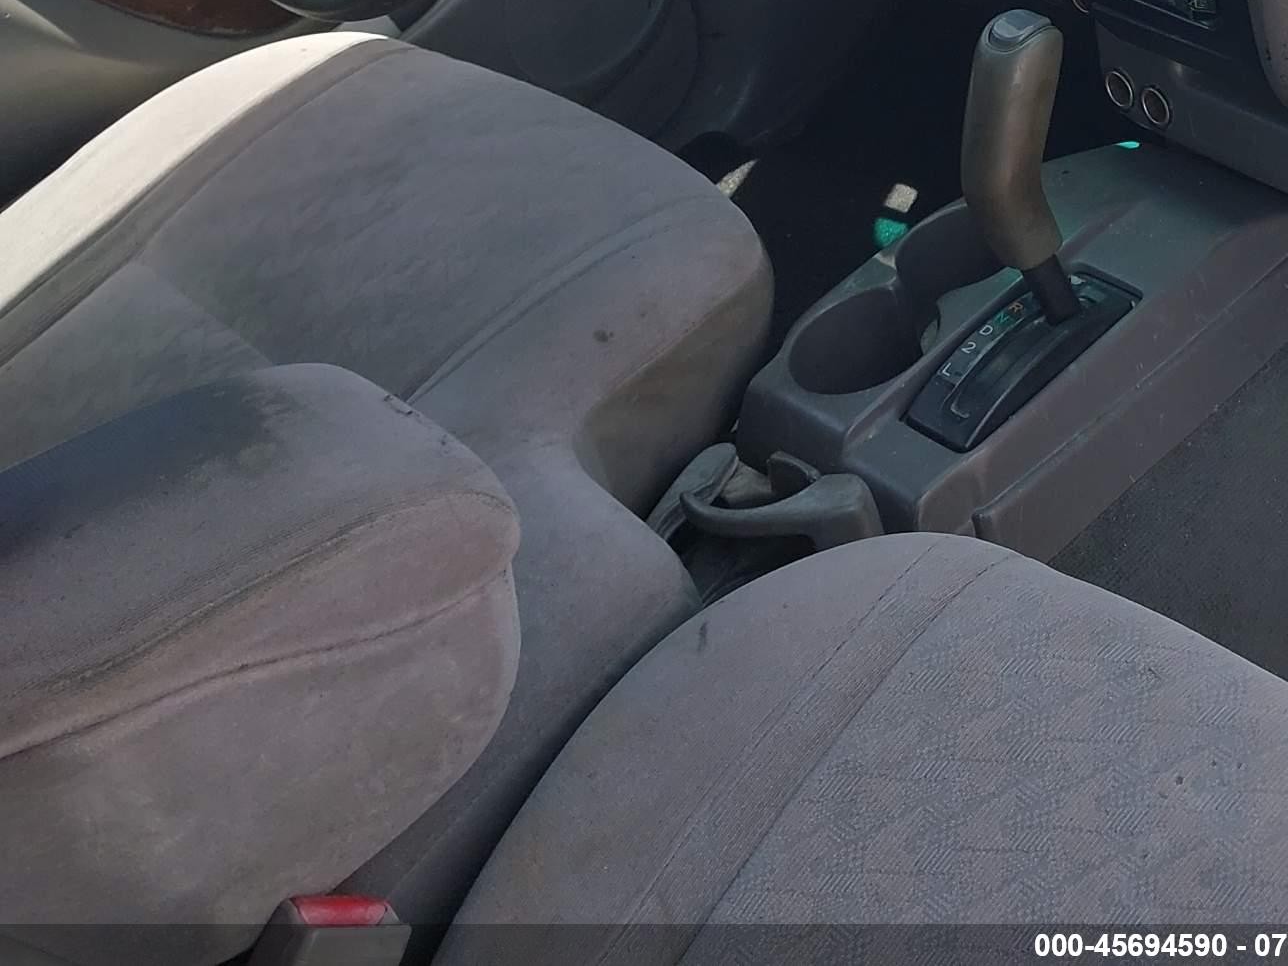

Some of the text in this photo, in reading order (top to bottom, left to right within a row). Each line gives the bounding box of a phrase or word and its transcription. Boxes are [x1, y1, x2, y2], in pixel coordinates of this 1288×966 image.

[1009, 302, 1023, 313] R
[979, 324, 994, 336] D
[961, 341, 977, 354] 2
[942, 362, 953, 377] L
